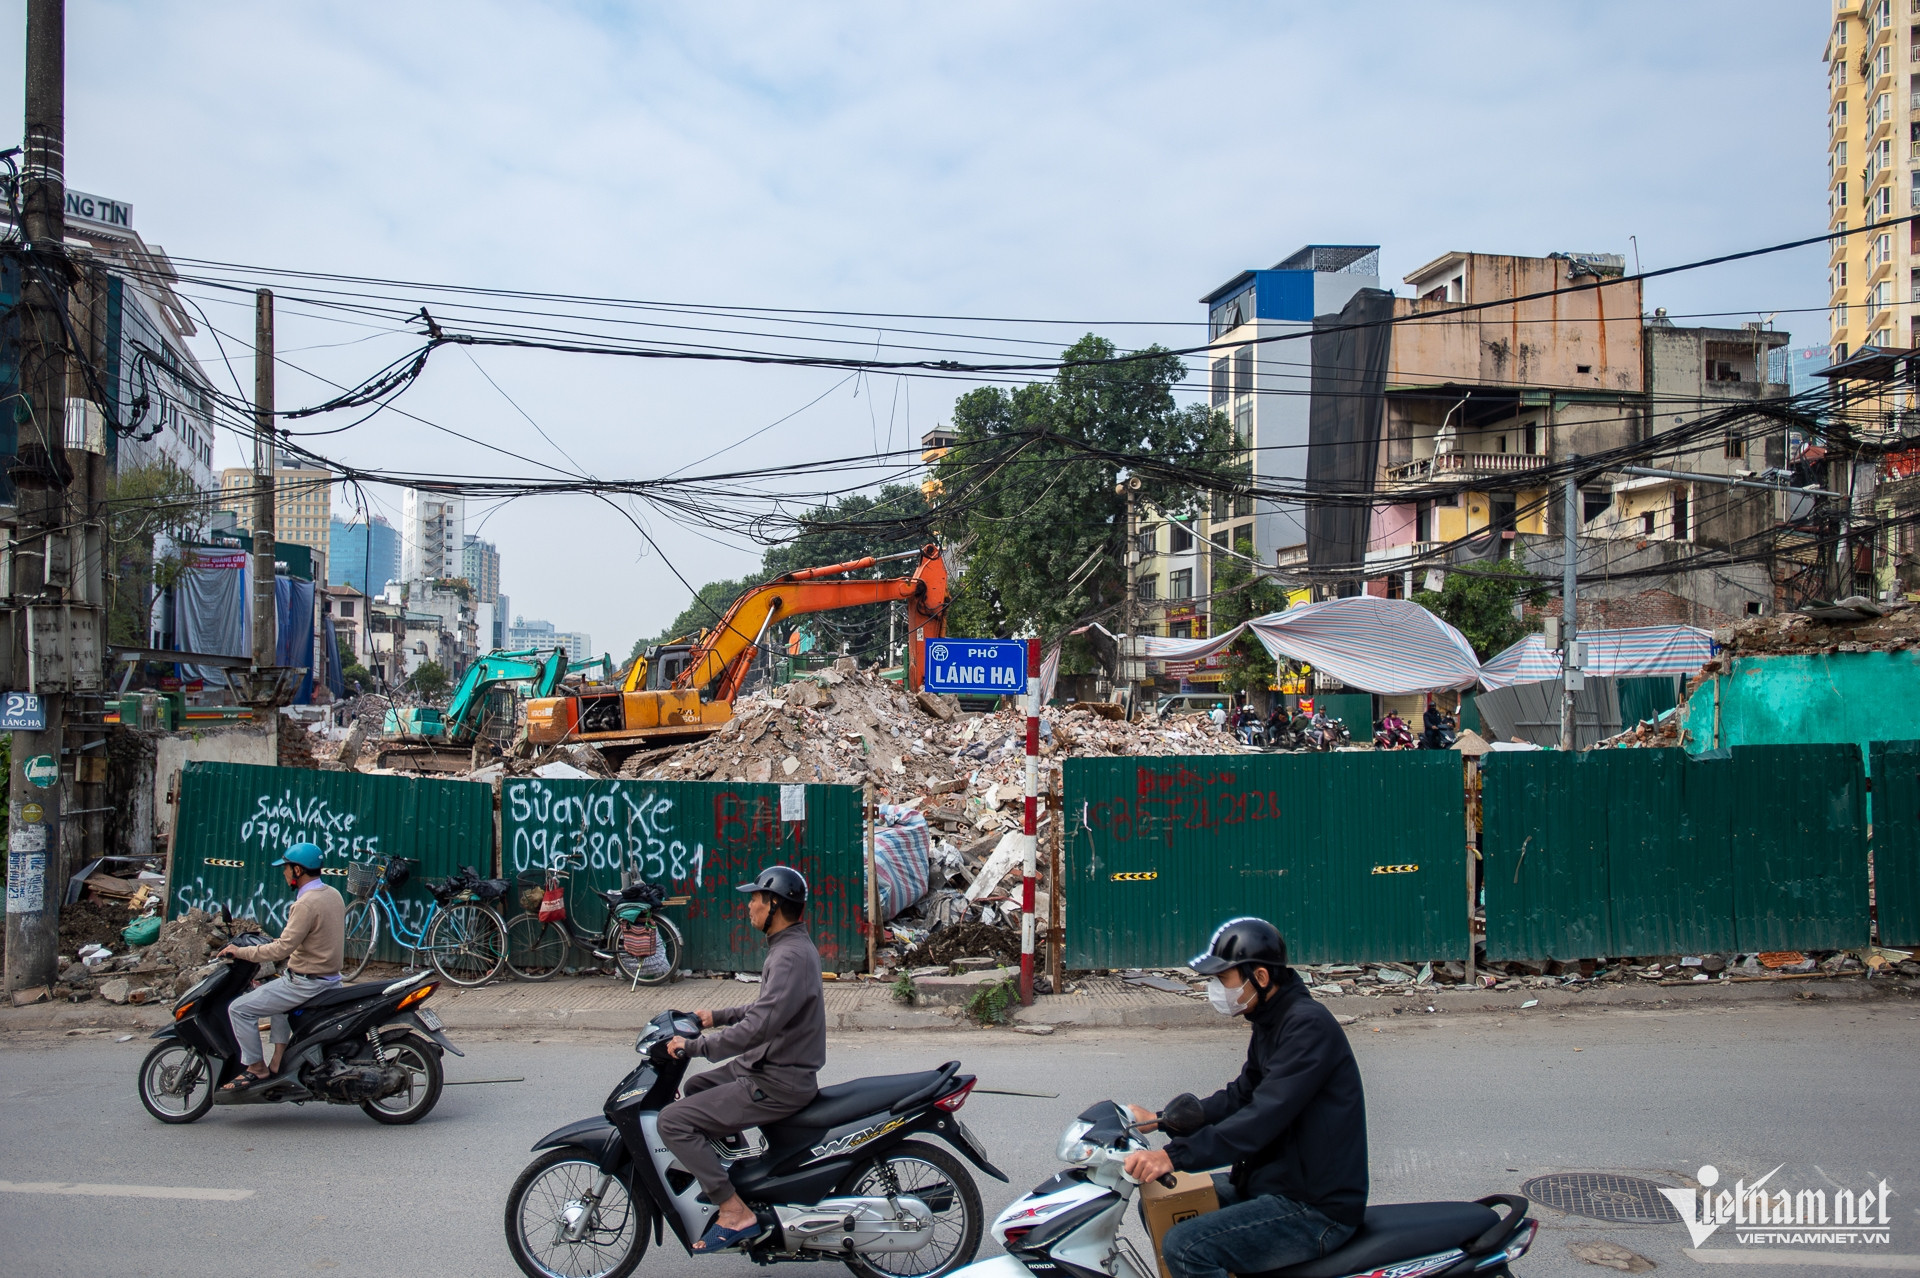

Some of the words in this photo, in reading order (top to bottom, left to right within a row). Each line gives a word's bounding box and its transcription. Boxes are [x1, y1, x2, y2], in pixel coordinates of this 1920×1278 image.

[64, 192, 95, 217] NG
[968, 645, 999, 659] PHỐ
[935, 661, 986, 684] LÁNG
[990, 666, 1017, 688] HẠ
[6, 695, 39, 717] 2E
[2, 717, 27, 727] LÁNG
[27, 719, 42, 728] HẠ
[512, 827, 705, 889] 0963803381
